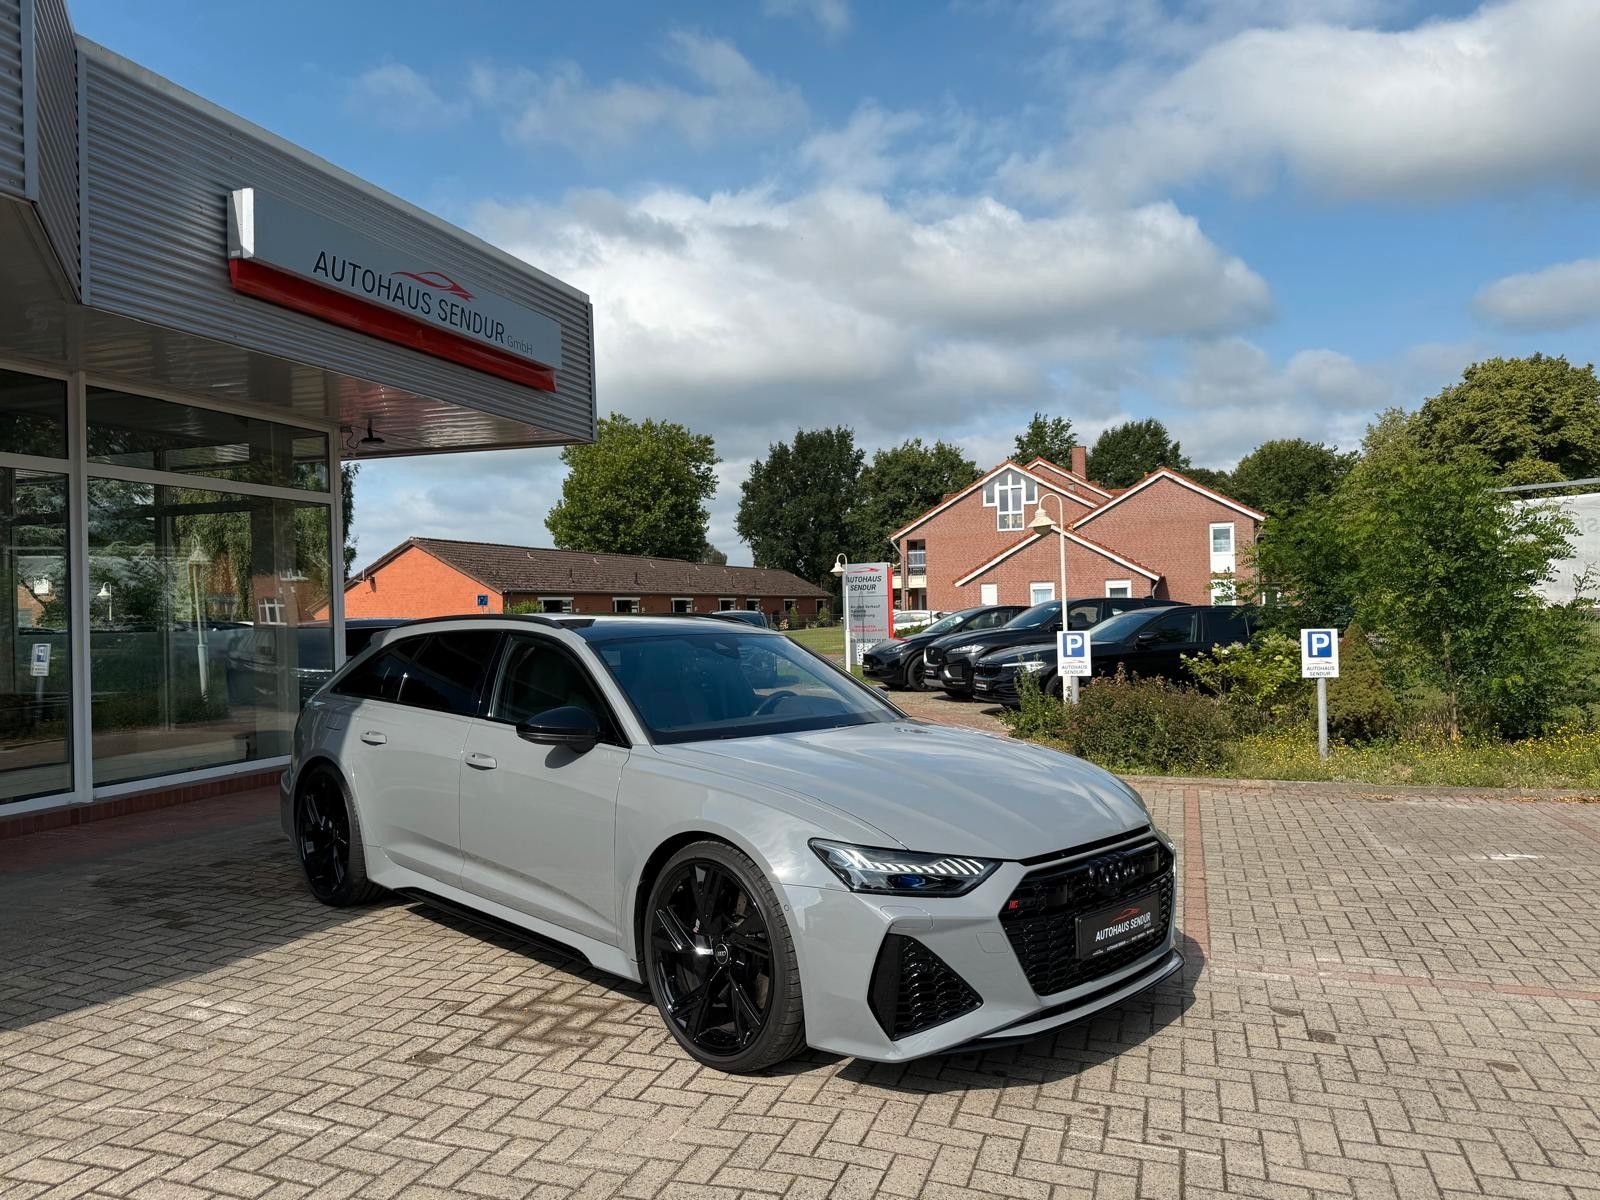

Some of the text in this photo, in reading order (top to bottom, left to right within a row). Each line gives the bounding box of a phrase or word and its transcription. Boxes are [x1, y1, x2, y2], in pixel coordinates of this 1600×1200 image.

[313, 250, 533, 355] AUTOHAUS SENDUR GmbH
[1066, 634, 1083, 656] P
[1311, 633, 1330, 656] P
[1095, 920, 1130, 942] AUTOHAUS
[1130, 911, 1151, 929] SENDUR
